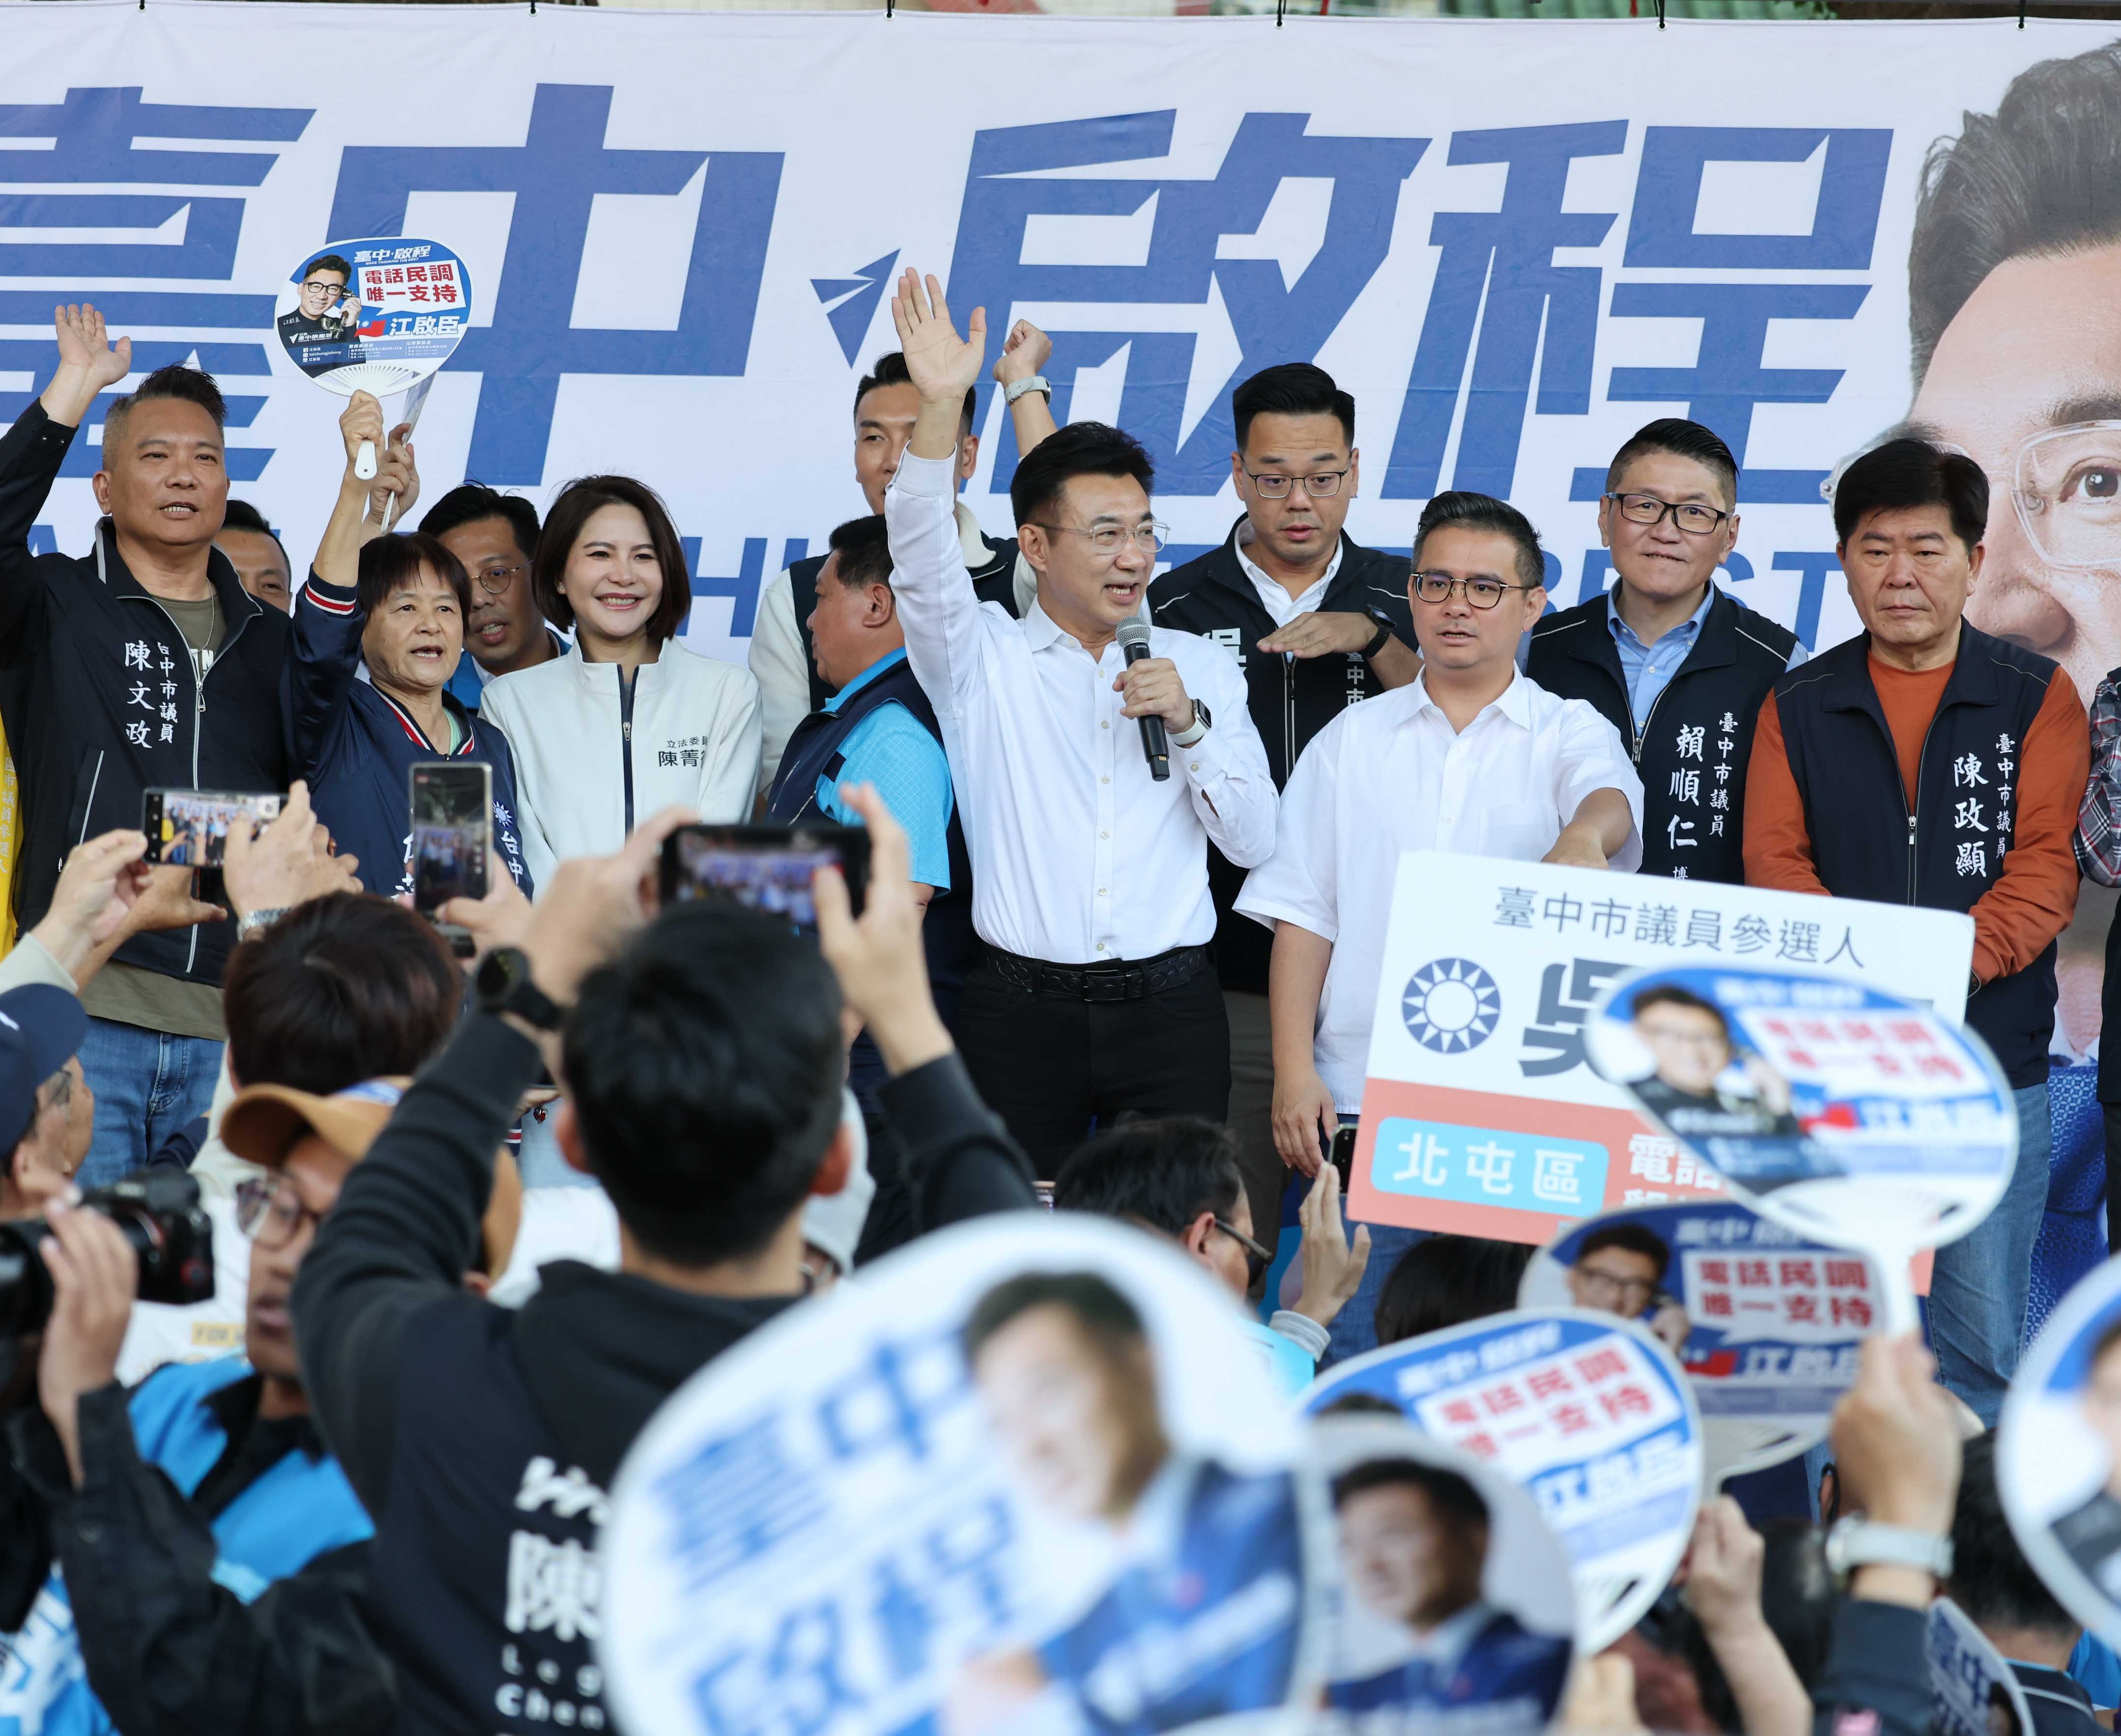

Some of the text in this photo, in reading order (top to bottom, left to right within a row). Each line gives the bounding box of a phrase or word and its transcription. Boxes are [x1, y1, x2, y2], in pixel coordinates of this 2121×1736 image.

[365, 263, 454, 284] 電話民調
[367, 284, 457, 302] 唯一支持
[389, 315, 460, 336] 江啟臣
[125, 640, 155, 748] 陳文政
[157, 642, 178, 743] 台中市議員
[1667, 723, 1706, 850] 賴順仁
[1709, 711, 1739, 838] 臺中市議員
[1954, 752, 1989, 878] 陳政顯
[1995, 732, 2015, 859] 臺中市議員
[1492, 885, 1866, 969] 臺中市議員參選人
[1391, 1130, 1587, 1204] 北屯區
